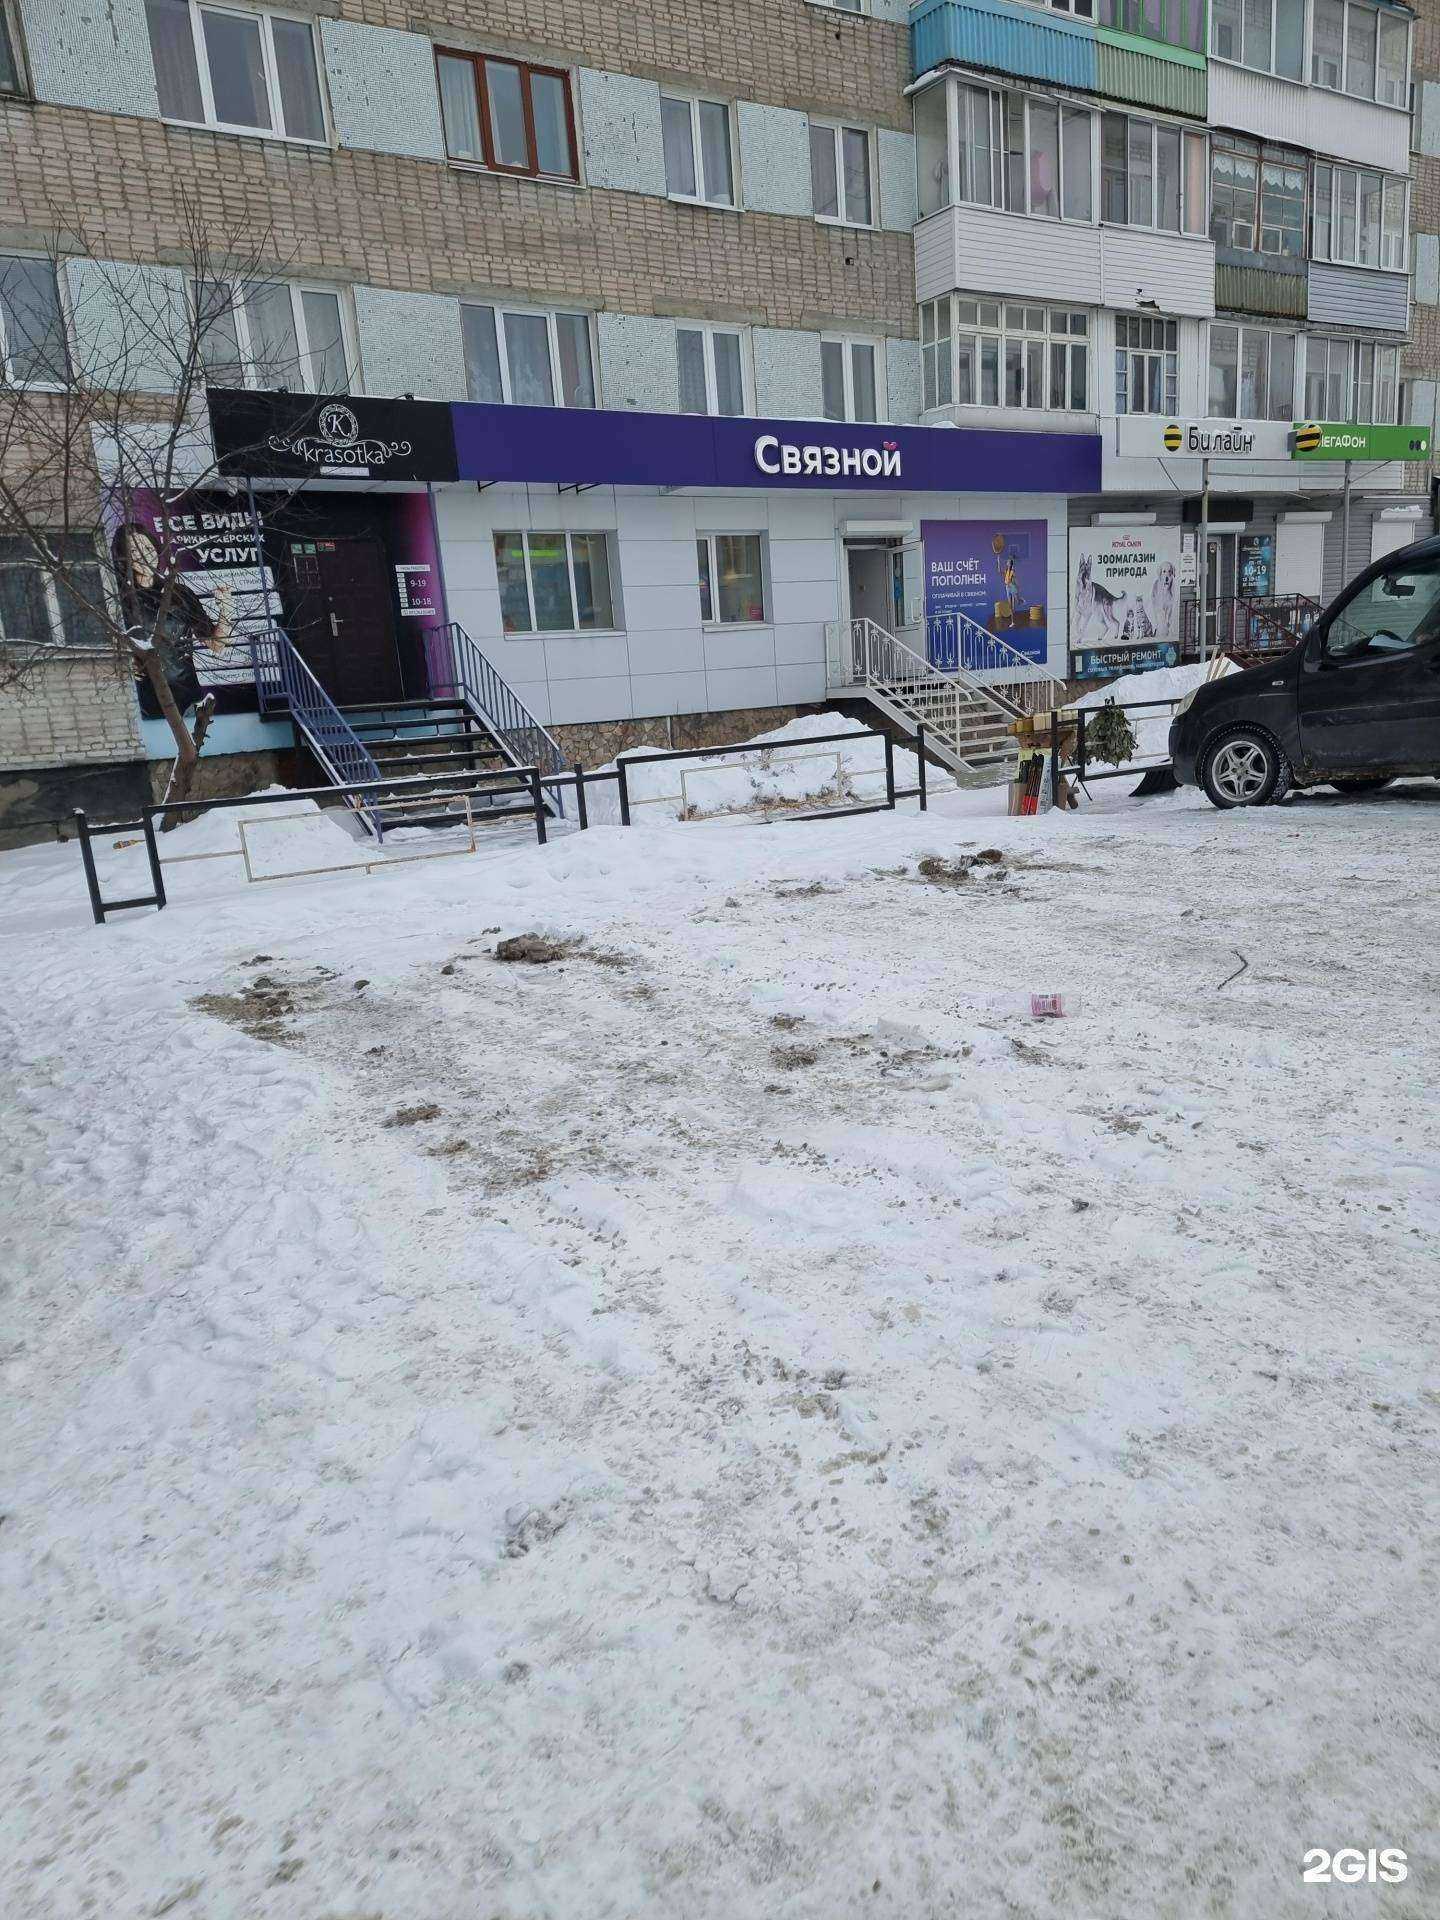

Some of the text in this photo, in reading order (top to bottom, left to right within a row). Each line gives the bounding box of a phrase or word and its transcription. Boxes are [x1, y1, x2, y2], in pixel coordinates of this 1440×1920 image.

[1188, 425, 1253, 451] Билайн
[304, 441, 386, 465] krasotka
[754, 434, 902, 477] Связной
[196, 546, 258, 563] УСЛУГ
[1097, 552, 1156, 565] ЗООМАГАЗИН
[931, 558, 980, 573] ВАШ СЧЁТ
[1105, 566, 1148, 578] ПРИРОДА
[410, 579, 427, 587] 9-19
[931, 573, 987, 587] ПОПОЛНЕН
[1090, 650, 1162, 665] БЫСТРЫЙ РЕМОНТ
